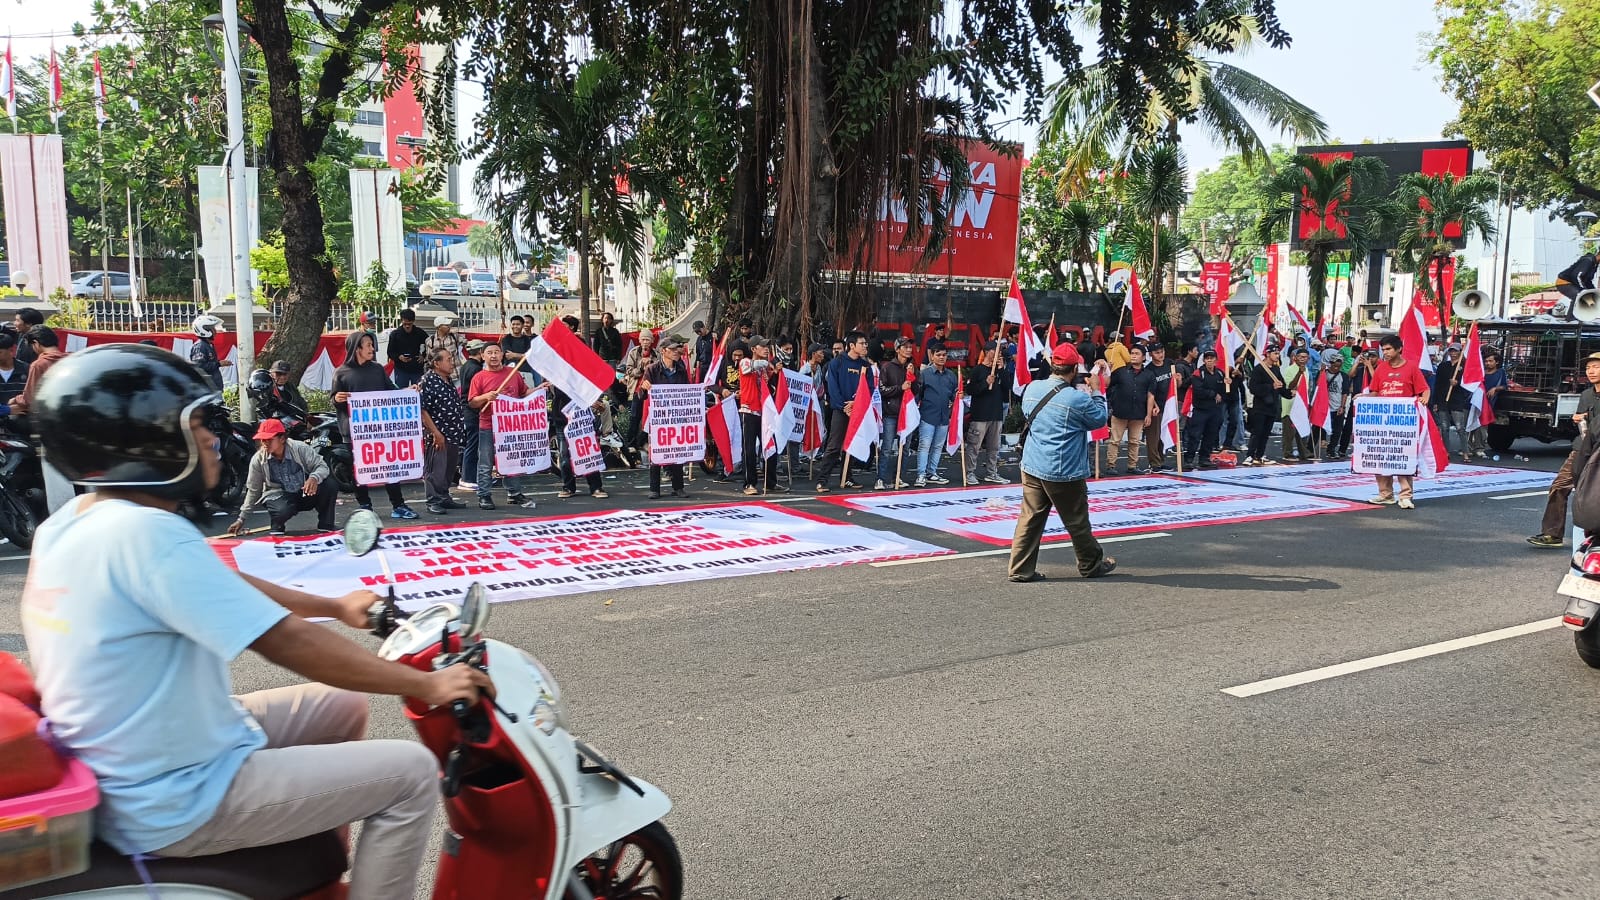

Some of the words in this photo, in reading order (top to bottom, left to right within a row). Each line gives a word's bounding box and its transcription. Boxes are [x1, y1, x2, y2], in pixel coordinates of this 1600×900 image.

[351, 400, 371, 408] TOLAK
[373, 397, 417, 407] DEMONSTRASI
[496, 399, 524, 413] TOLAK
[671, 398, 700, 406] KEKERASAN
[352, 406, 418, 422] ANARKIS!
[654, 410, 666, 418] DAN
[668, 408, 700, 417] PERUSAKAN
[1357, 403, 1390, 414] ASPIRASI
[1392, 404, 1416, 415] BOLEH
[497, 412, 547, 433] ANARKIS
[671, 416, 702, 424] DEMONSTRASI
[1355, 414, 1383, 425] ANARKI
[1384, 415, 1417, 426] JANGAN!
[353, 424, 382, 433] SILAKAN
[384, 421, 418, 431] BERSUARA
[504, 435, 516, 443] JAGA
[658, 425, 698, 446] GPJCI
[1355, 429, 1388, 438] Sampaikan
[1389, 430, 1416, 439] Pendapat
[361, 439, 415, 464] GPJCI
[498, 444, 511, 452] JAGA
[512, 442, 536, 451] FASILITAS
[575, 436, 601, 457] GPJ
[521, 449, 546, 458] INDONESIA
[1361, 453, 1384, 461] Pemuda
[520, 459, 535, 467] GPJCI
[1378, 462, 1407, 470] Indonesia
[876, 500, 956, 510] TOLAK
[393, 536, 498, 548] JAKARTA
[401, 542, 499, 556] STOP
[508, 525, 704, 546] PROVOKASI
[360, 562, 516, 586] KAWAL
[518, 534, 800, 569] PEMBANGUNAN!
[421, 551, 520, 566] JAGA
[585, 561, 692, 580] JAKARTA
[692, 557, 763, 569] CINTA
[761, 546, 872, 560] INDONESIA
